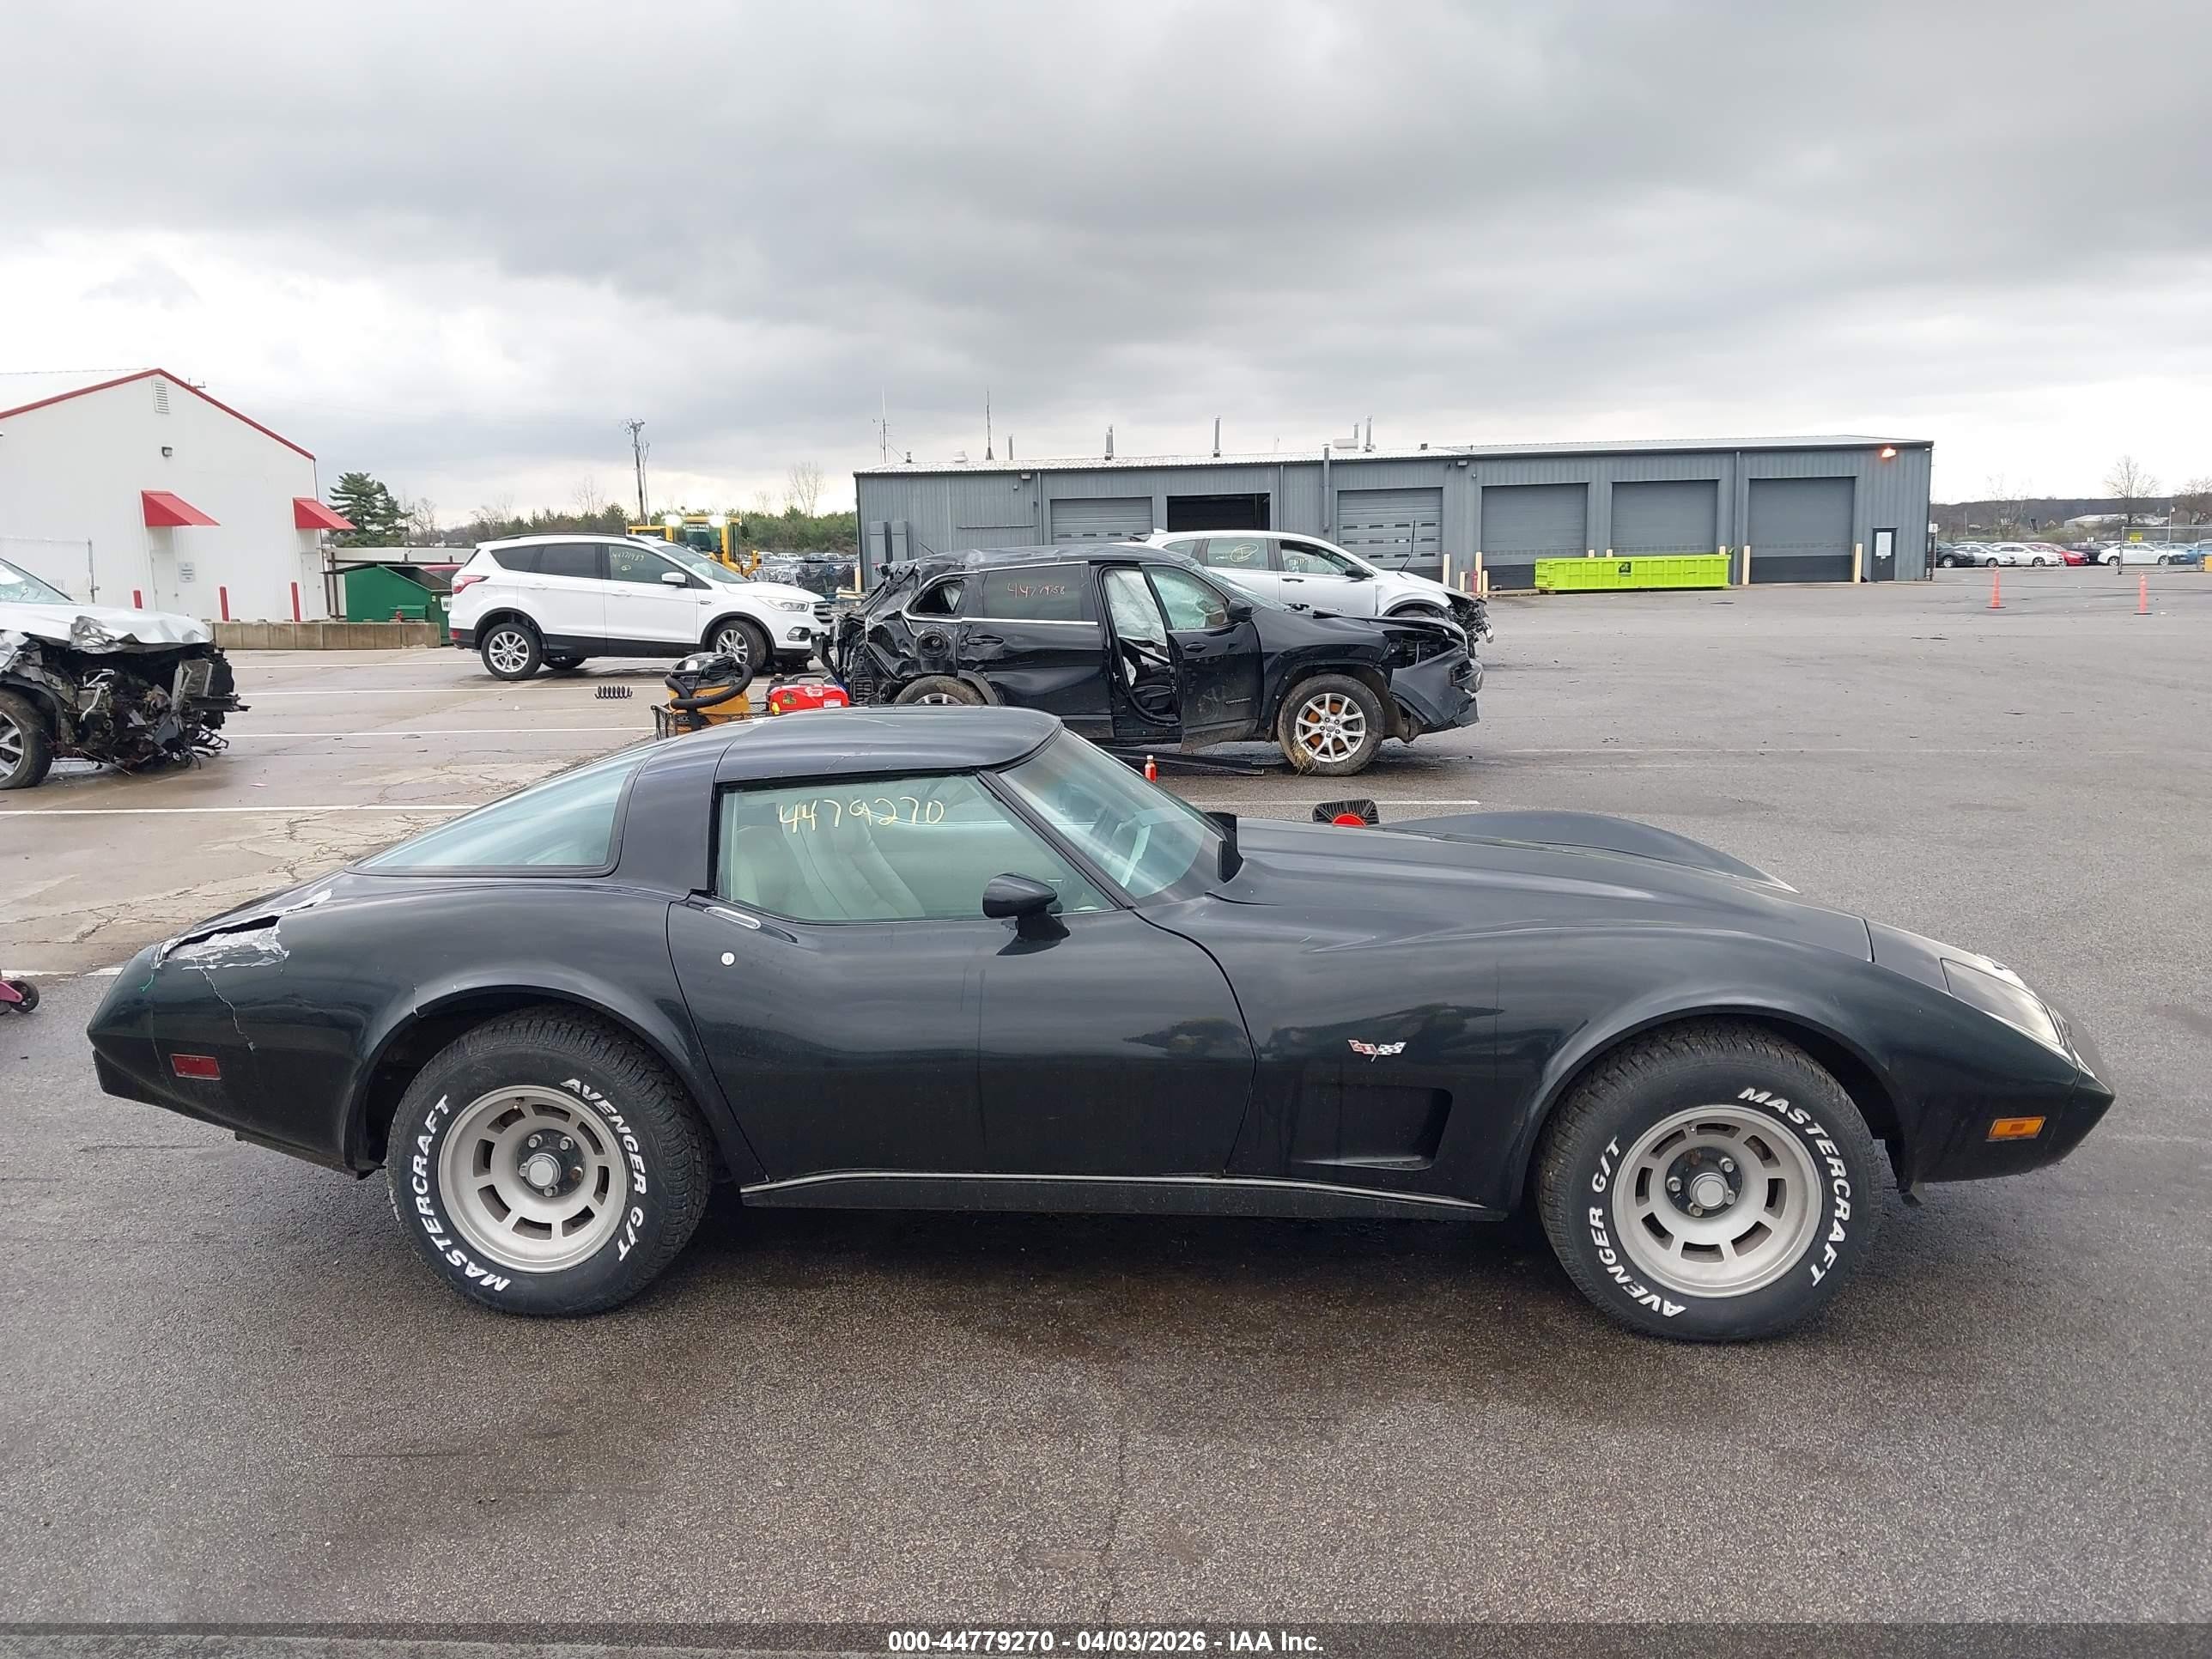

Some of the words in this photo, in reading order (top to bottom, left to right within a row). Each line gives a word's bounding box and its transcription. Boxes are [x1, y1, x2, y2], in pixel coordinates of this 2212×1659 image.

[412, 1094, 511, 1291] MASTERCRAFT
[560, 1079, 647, 1195] AVENGER
[1592, 1136, 1621, 1193] G/T
[1738, 1087, 1851, 1287] MASTERCRAFT
[1589, 1206, 1687, 1317] AVENGER
